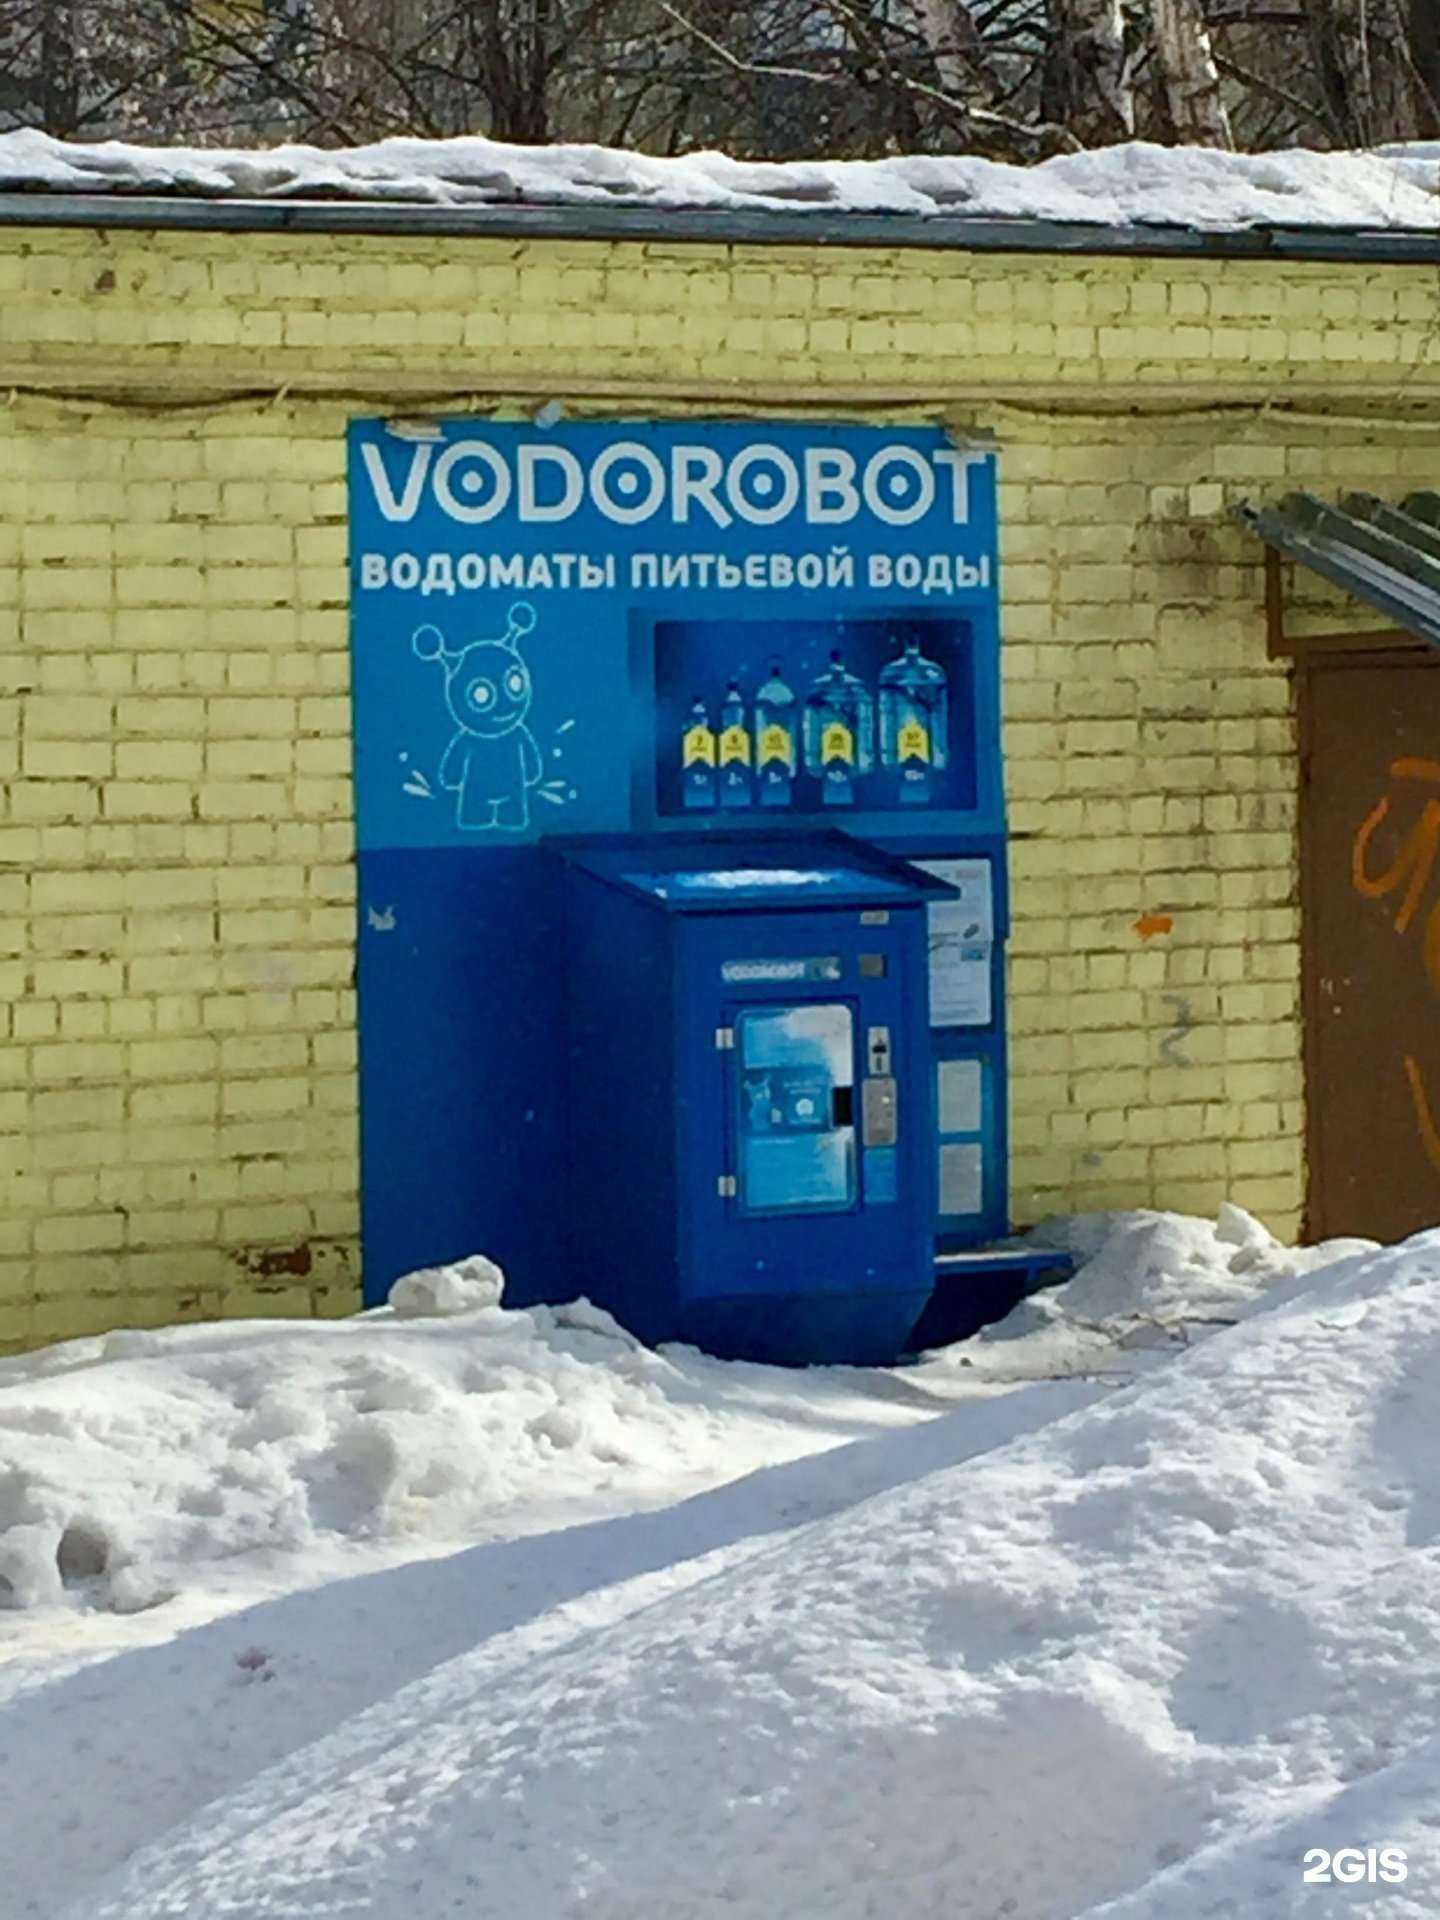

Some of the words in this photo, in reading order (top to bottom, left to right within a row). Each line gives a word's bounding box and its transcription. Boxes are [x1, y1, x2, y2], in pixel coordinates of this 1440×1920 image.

[361, 440, 987, 528] VODOROBOT
[360, 553, 616, 596] ВОДОМАТЫ
[631, 546, 854, 588] ПИТЬЕВОЙ
[868, 555, 990, 595] ВОДЫ
